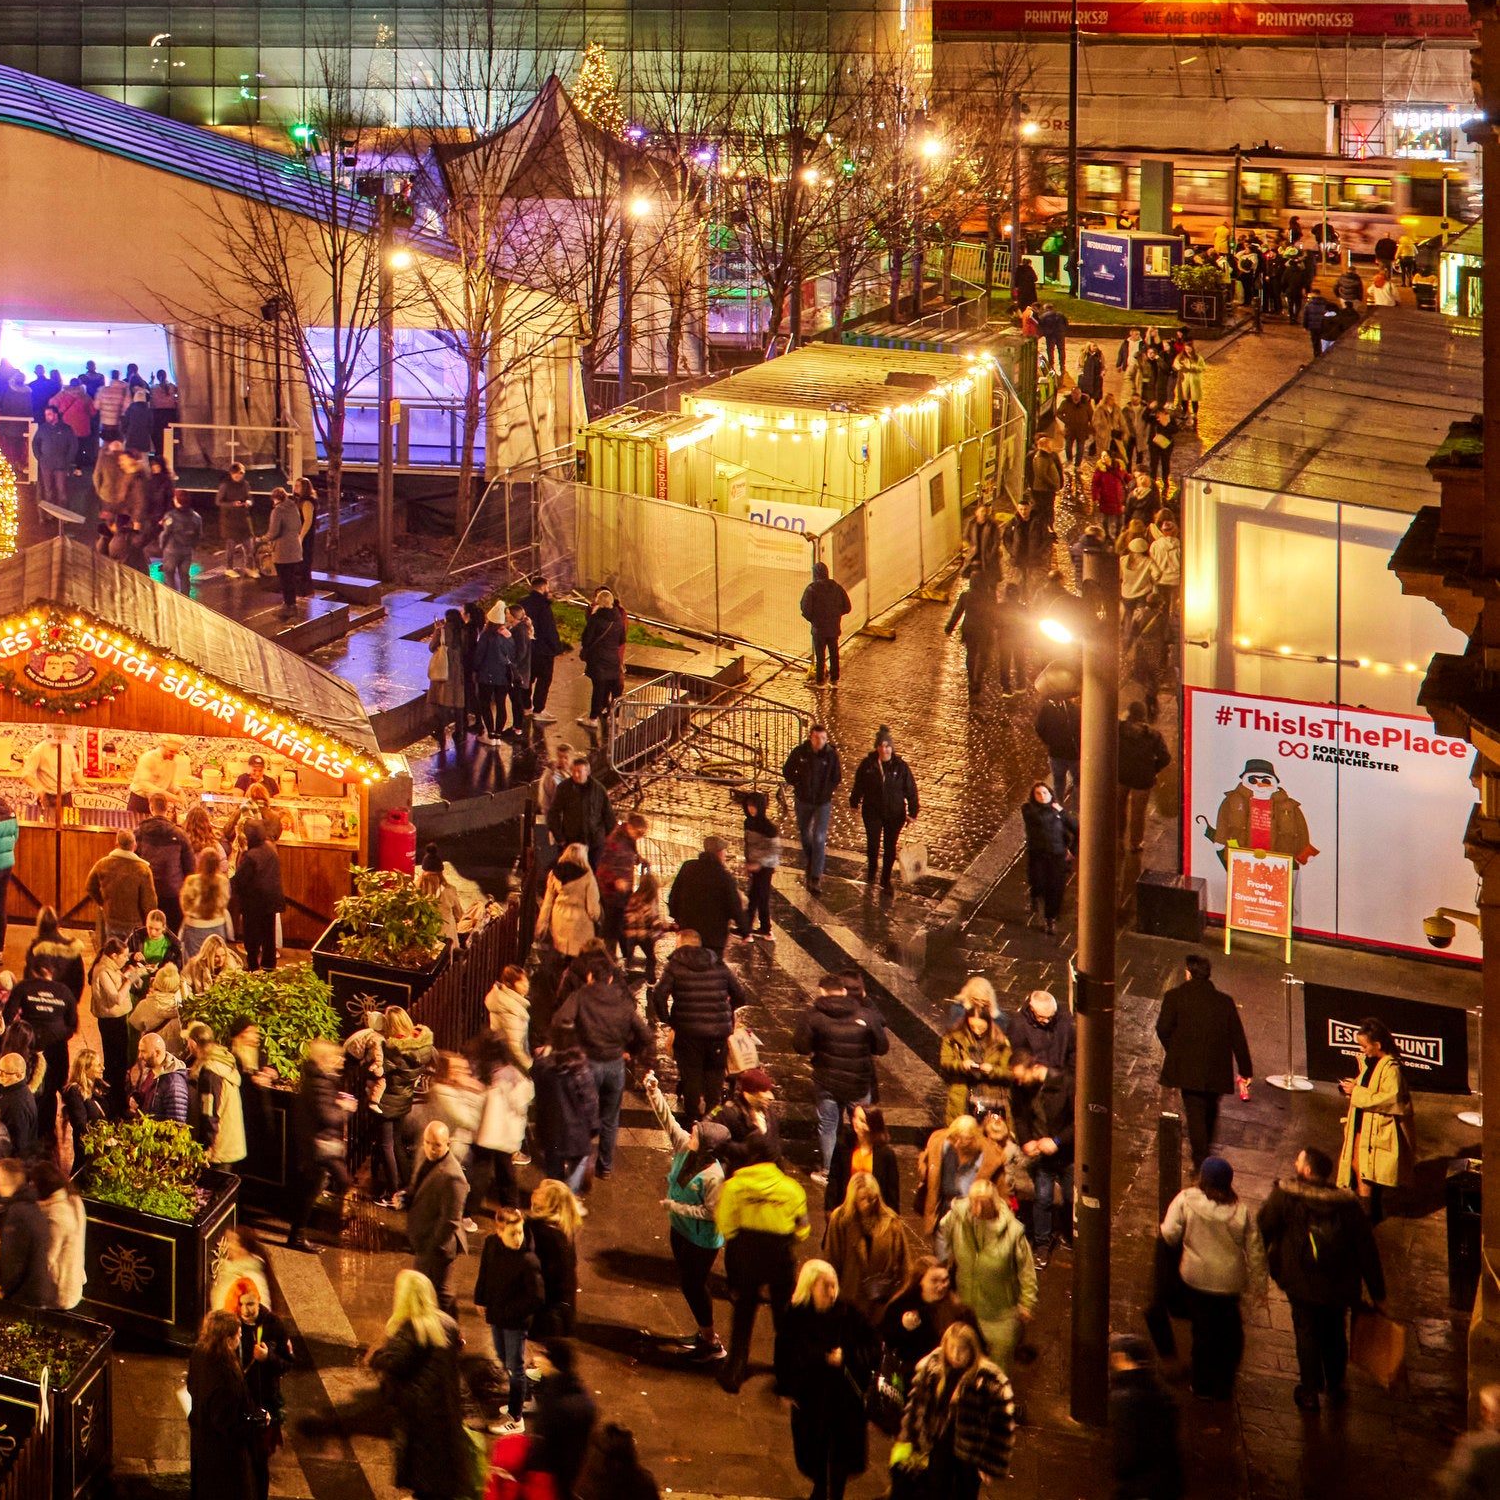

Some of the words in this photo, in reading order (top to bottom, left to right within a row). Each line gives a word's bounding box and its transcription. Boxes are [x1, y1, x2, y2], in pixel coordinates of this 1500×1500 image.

[1143, 11, 1161, 25] WE
[1165, 11, 1186, 25] ARE
[1191, 11, 1222, 25] OPEN
[1418, 13, 1441, 28] ARE
[35, 676, 55, 688] DUTCH
[79, 631, 158, 684] DUTCH
[159, 674, 237, 724] SUGAR
[242, 713, 348, 780] WAFFLES
[1215, 705, 1468, 759] #ThisIsThePlace
[1312, 744, 1371, 761] FOREVER
[1312, 752, 1399, 773] MANCHESTER
[1247, 879, 1274, 892] Frosty
[1234, 892, 1258, 903] Snow
[1254, 889, 1266, 897] the
